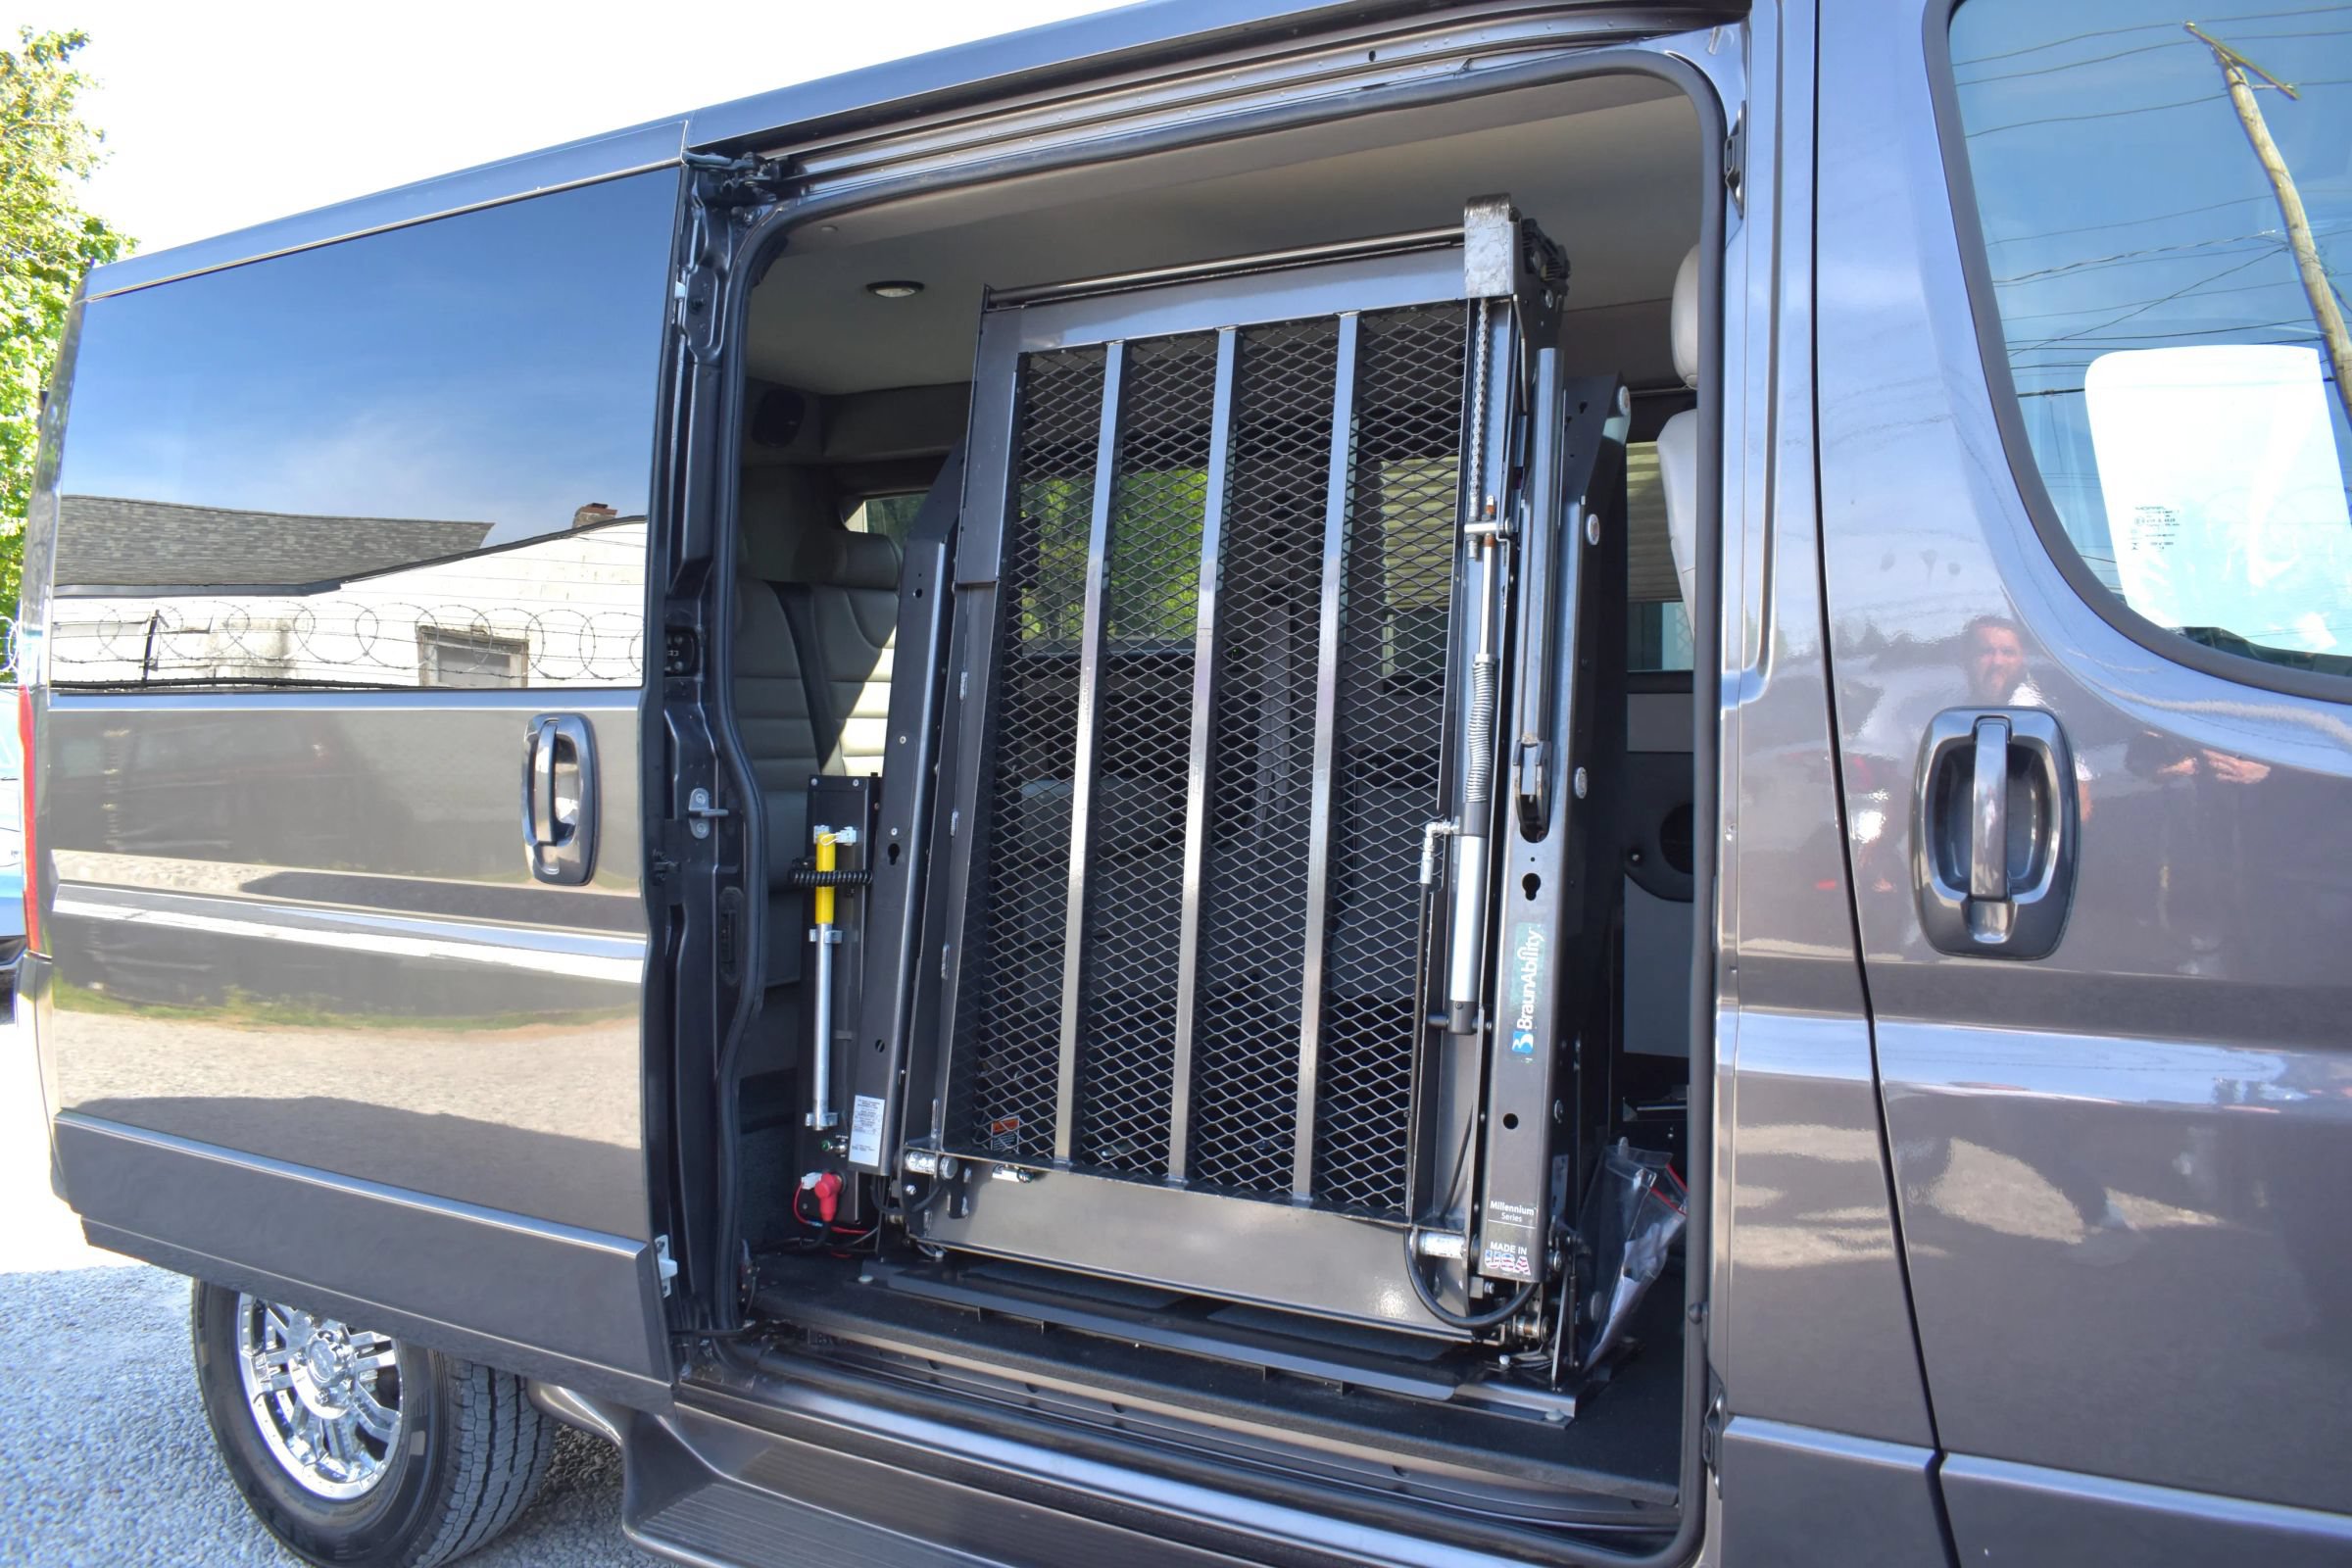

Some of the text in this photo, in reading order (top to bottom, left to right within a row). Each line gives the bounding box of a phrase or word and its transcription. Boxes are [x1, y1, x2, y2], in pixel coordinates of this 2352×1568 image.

[1517, 926, 1545, 1031] BraunAbility
[1501, 1212, 1522, 1222] Series
[1490, 1241, 1528, 1255] MADE IN
[1485, 1249, 1532, 1276] USA
